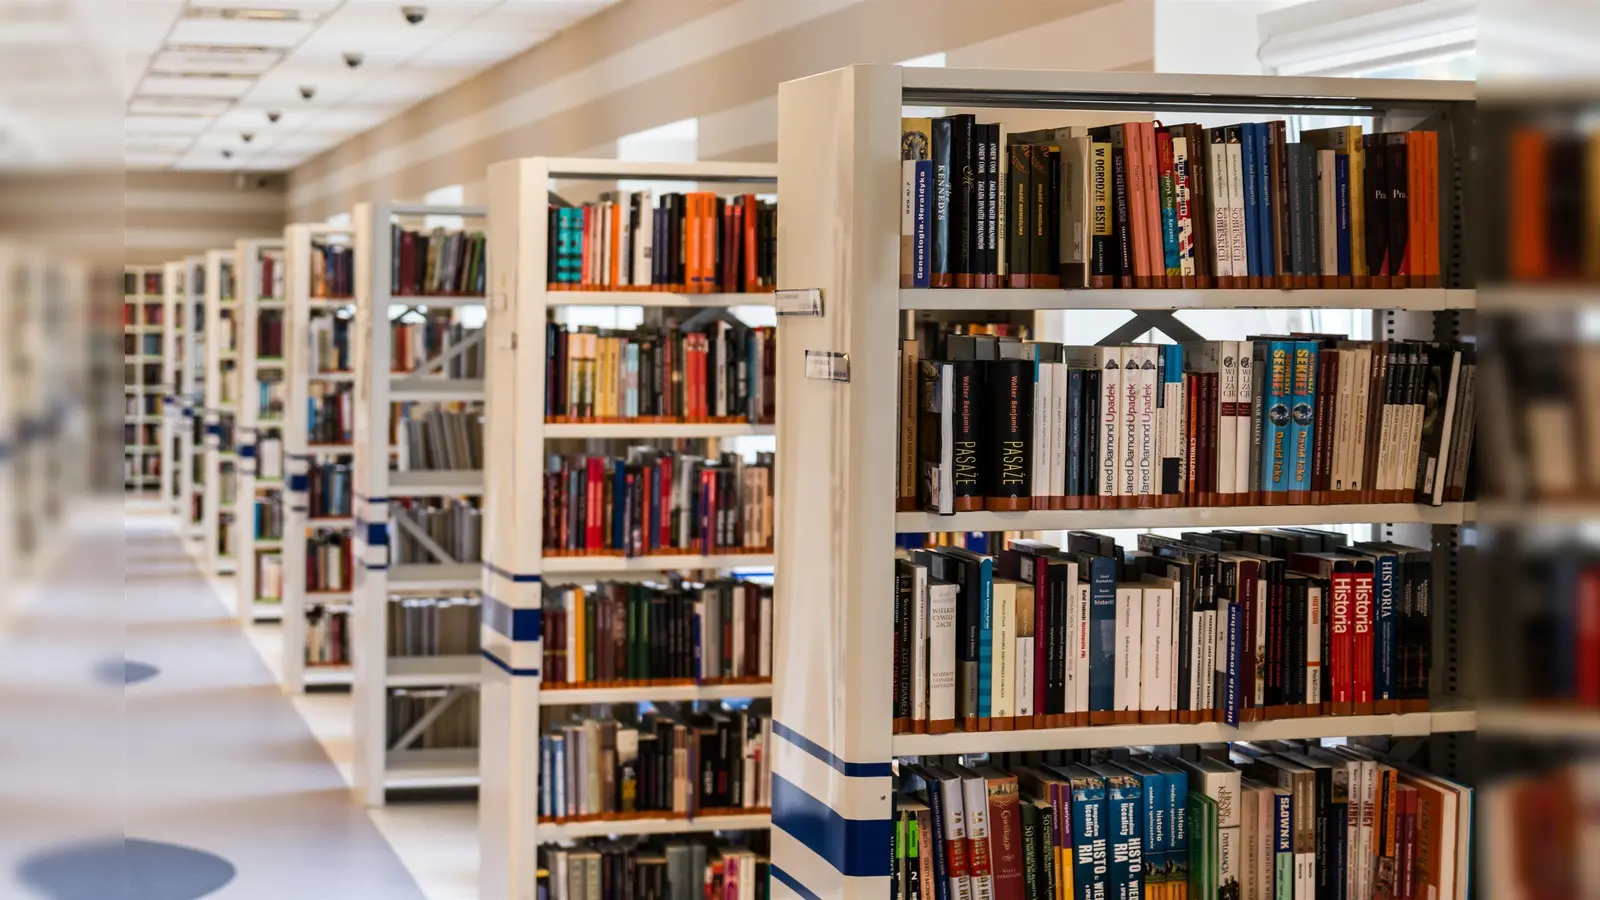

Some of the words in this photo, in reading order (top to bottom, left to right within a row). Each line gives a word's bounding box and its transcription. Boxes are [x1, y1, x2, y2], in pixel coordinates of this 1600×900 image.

[977, 143, 986, 161] ANDREW
[989, 143, 997, 161] ANDREW
[1095, 148, 1105, 157] W
[1115, 155, 1124, 174] SZEŚĆ
[977, 161, 986, 174] COOK
[989, 161, 997, 174] COOK
[1095, 159, 1105, 203] OGRODZIE
[1177, 154, 1186, 182] TAJEMNICE
[937, 165, 946, 220] KENNEDYS
[944, 182, 952, 202] The
[977, 181, 986, 200] ZAGŁADA
[988, 181, 997, 200] ZAGŁADA
[1116, 174, 1125, 196] PIĘTER
[1164, 169, 1173, 195] Fryderyk
[977, 200, 986, 220] DYNASTII
[988, 200, 997, 220] DYNASTII
[1118, 196, 1127, 223] LUKSUSU
[1179, 184, 1187, 216] WINDSORÓW
[917, 171, 927, 279] Genealogia.Heraldyka
[1095, 205, 1105, 233] BESTII
[977, 221, 986, 250] ROMANOWÓW
[988, 221, 997, 250] ROMANOWÓW
[1215, 207, 1226, 262] SOBIESKICH
[1231, 207, 1242, 262] SOBIESKICH
[1010, 375, 1018, 398] Walter
[1271, 349, 1285, 398] SEKRET
[1295, 349, 1309, 397] SEKRET
[1307, 353, 1315, 394] NAJWIĘKSZY
[960, 400, 970, 433] Benjamin
[1009, 400, 1018, 433] Benjamin
[1105, 384, 1117, 423] Upadek
[1125, 384, 1137, 423] Upadek
[1141, 384, 1153, 423] Upadek
[1256, 395, 1264, 416] OSKAR
[1255, 418, 1263, 445] HALECKI
[1274, 431, 1284, 458] David
[1297, 431, 1307, 458] David
[1382, 429, 1390, 452] HISTORII
[1104, 424, 1114, 468] Diamond
[1124, 424, 1135, 468] Diamond
[1140, 424, 1151, 468] Diamond
[955, 441, 978, 486] PASAŻE
[1003, 441, 1026, 486] PASAŻE
[1272, 461, 1282, 482] Icke
[1296, 460, 1305, 482] Icke
[1104, 469, 1114, 497] Jared
[1124, 469, 1135, 497] Jared
[1140, 469, 1150, 496] Jared
[1381, 561, 1392, 618] HISTORIA
[1312, 596, 1320, 625] HISTORIA
[1334, 577, 1351, 633] Historia
[1355, 577, 1373, 633] Historia
[1228, 606, 1237, 675] powszechna
[1227, 677, 1235, 723] Historia
[1223, 791, 1232, 818] HENRY
[1002, 810, 1012, 850] Cywilizacja
[1025, 825, 1034, 837] 50
[1042, 814, 1051, 825] 50
[1084, 804, 1095, 837] licealisty
[1119, 803, 1128, 836] licealisty
[1078, 844, 1094, 864] RIA
[1093, 838, 1107, 874] HISTO
[1113, 843, 1128, 863] RIA
[1128, 837, 1141, 873] HISTO
[1221, 832, 1230, 875] DYPLOMACJA
[911, 872, 917, 881] 2
